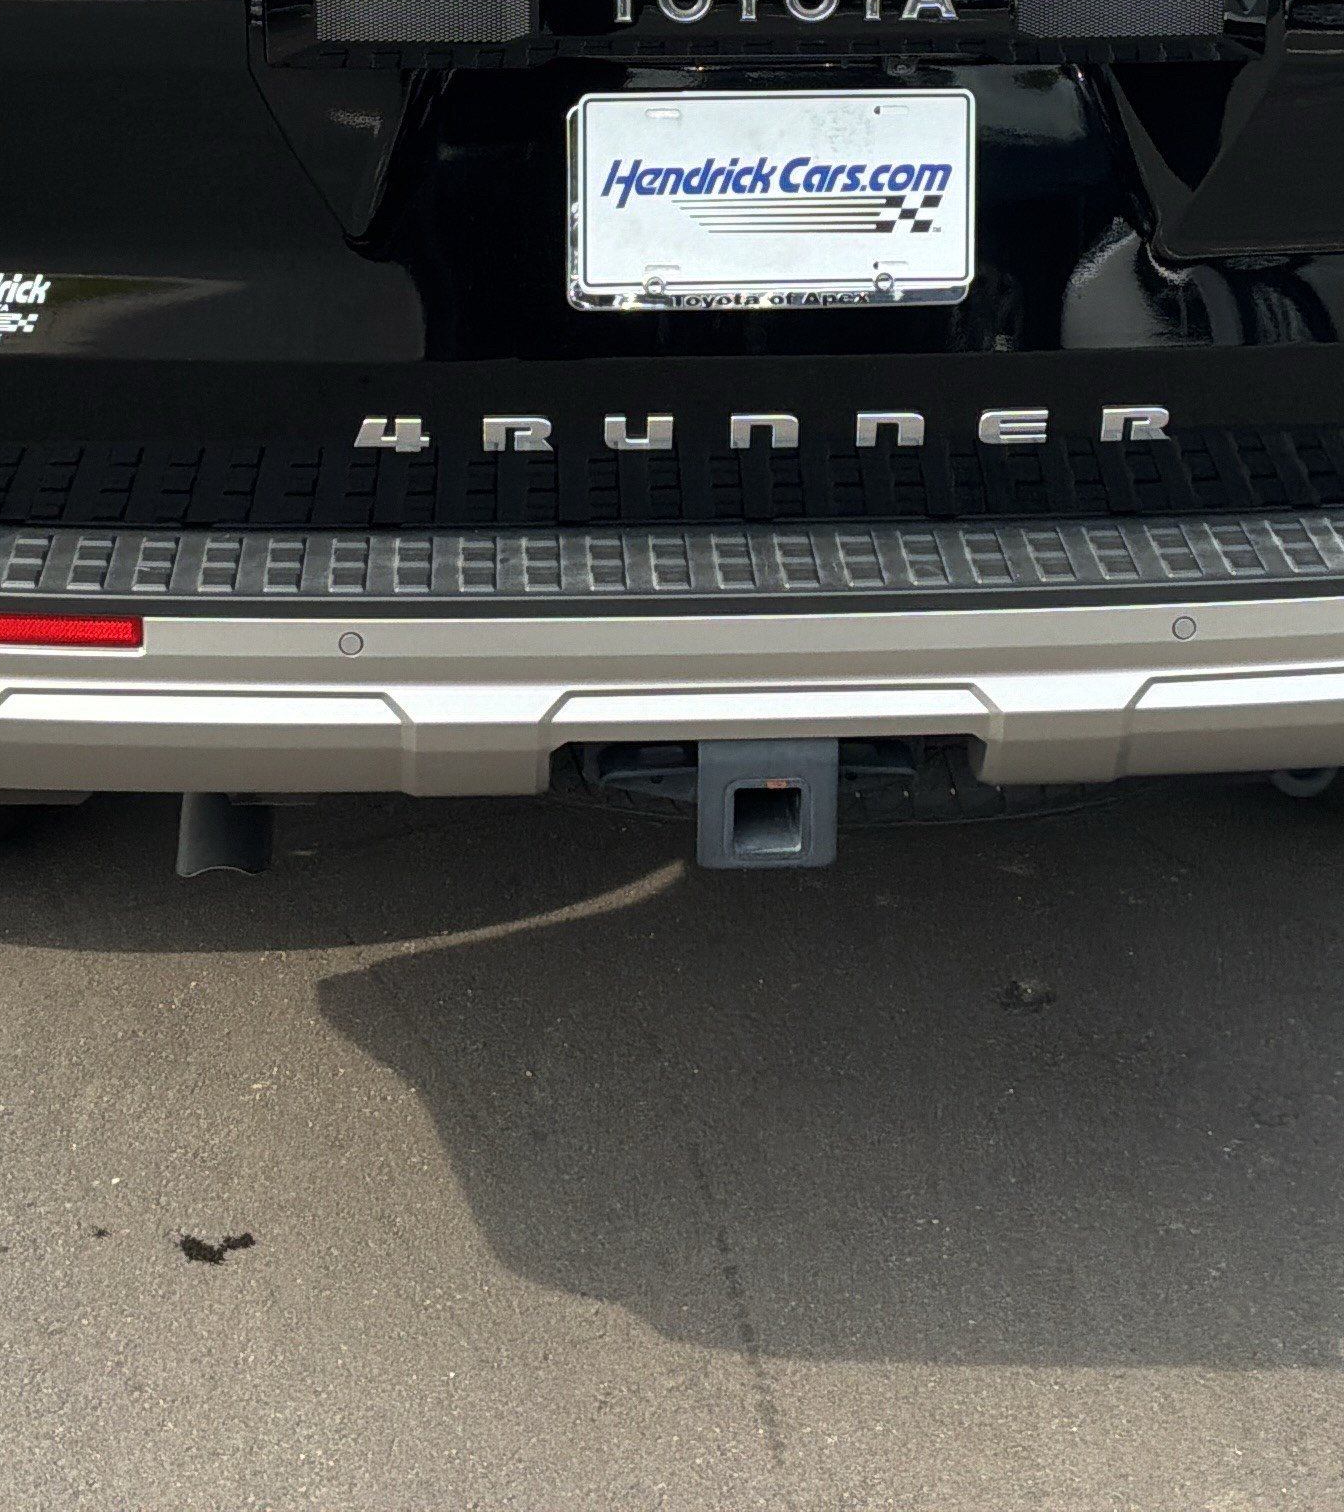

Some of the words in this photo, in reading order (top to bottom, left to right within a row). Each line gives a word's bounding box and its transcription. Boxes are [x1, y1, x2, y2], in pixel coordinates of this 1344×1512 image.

[671, 291, 761, 308] Toyota
[768, 291, 795, 305] of
[804, 291, 871, 307] Apex
